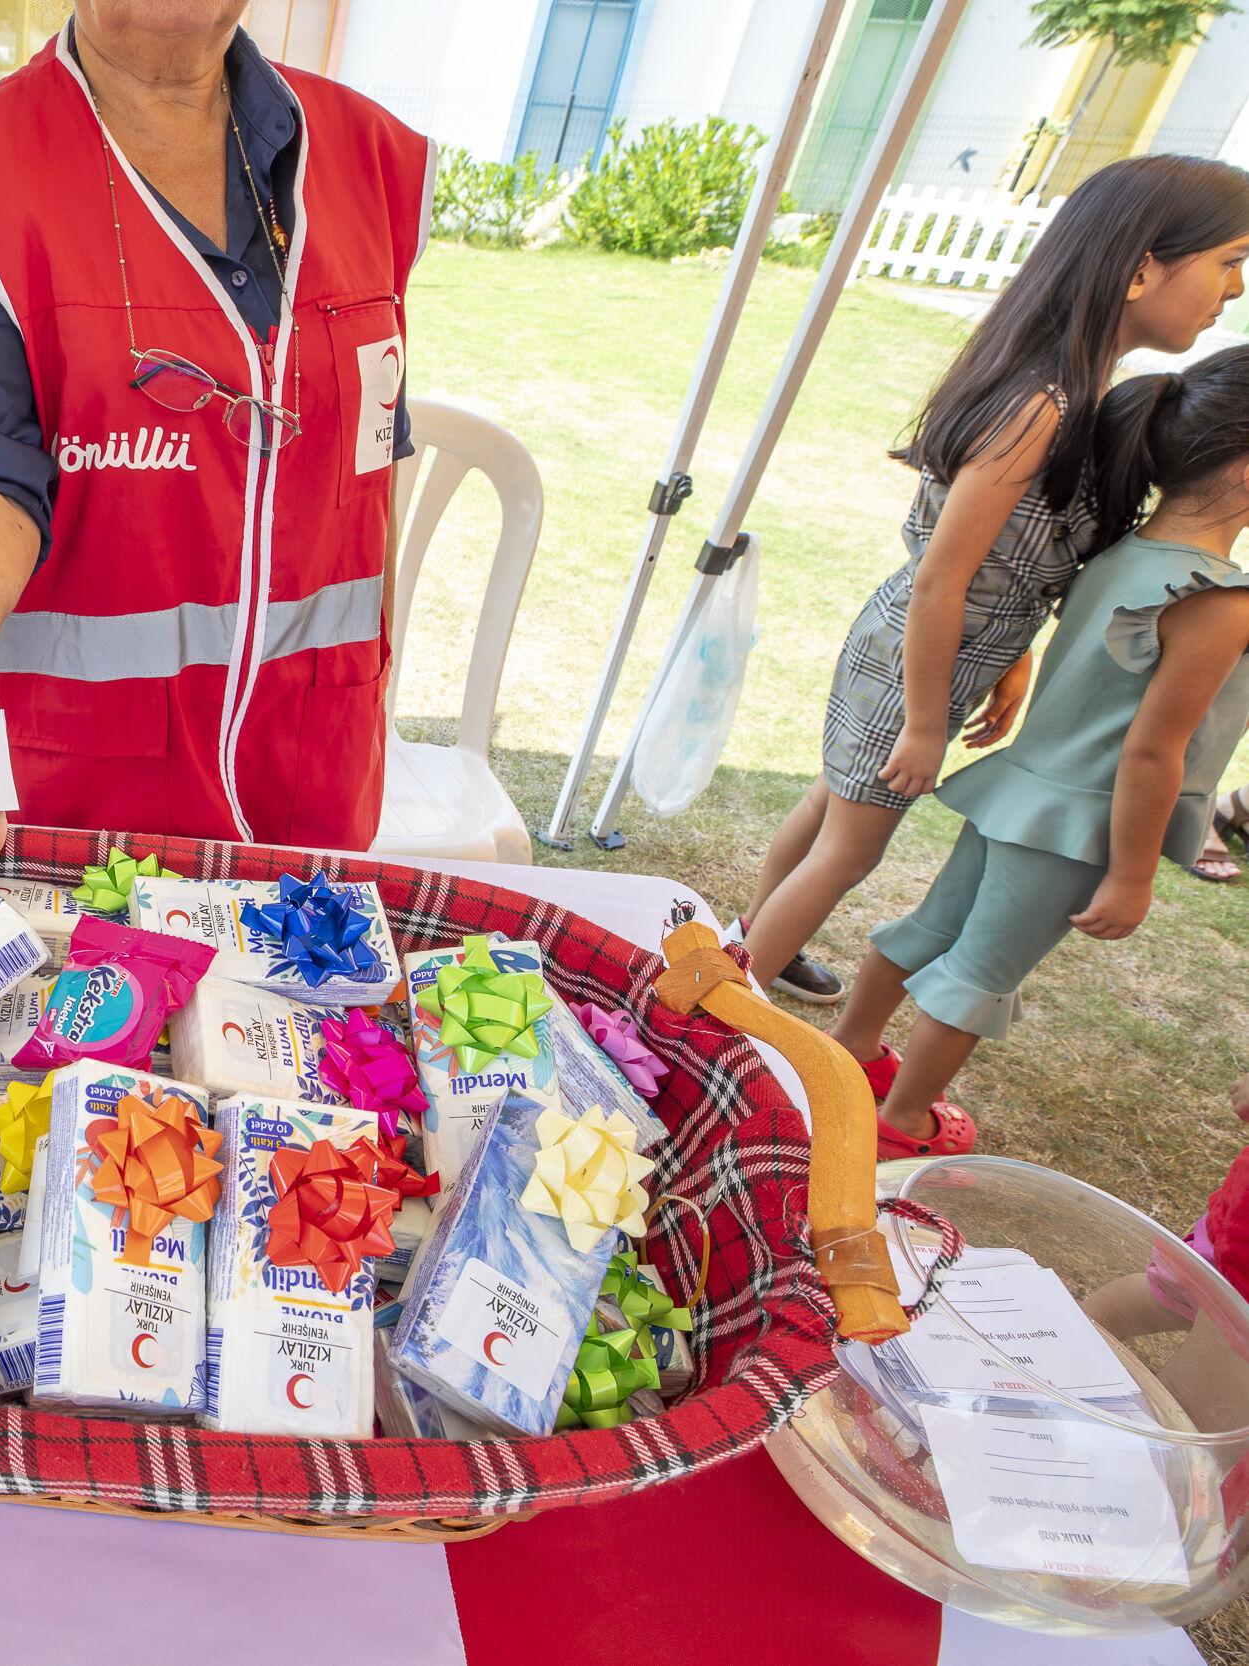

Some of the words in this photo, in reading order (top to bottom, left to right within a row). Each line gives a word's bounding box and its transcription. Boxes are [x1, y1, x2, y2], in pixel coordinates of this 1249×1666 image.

[51, 426, 197, 473] önüllü
[201, 903, 214, 938] KIZILAY
[216, 904, 226, 935] YENİŞEHİR
[110, 972, 130, 997] ÜLKER
[0, 993, 14, 1022] KIZILAY
[28, 991, 38, 1026] BLUME
[67, 964, 119, 1044] Kekstra
[251, 1018, 268, 1060] KIZILAY
[266, 1023, 278, 1059] YENİŞEHİR
[276, 1017, 293, 1067] BLUME
[293, 1011, 318, 1081] Mendil
[90, 1086, 113, 1098] Adet
[451, 1072, 527, 1095] Mendil
[89, 1101, 113, 1113] Katlı
[251, 1120, 274, 1132] Adet
[276, 1125, 288, 1134] 10
[250, 1136, 274, 1148] Katlı
[112, 1228, 184, 1262] Meil
[130, 1281, 171, 1302] YENİŞEHİR
[496, 1282, 540, 1317] YENİŞEHİR
[125, 1298, 173, 1324] KIZILAY
[486, 1296, 538, 1337] KIZILAY
[282, 1322, 329, 1340] YENİŞEHİR
[277, 1340, 332, 1363] KIZILAY
[0, 1383, 5, 1392] 8
